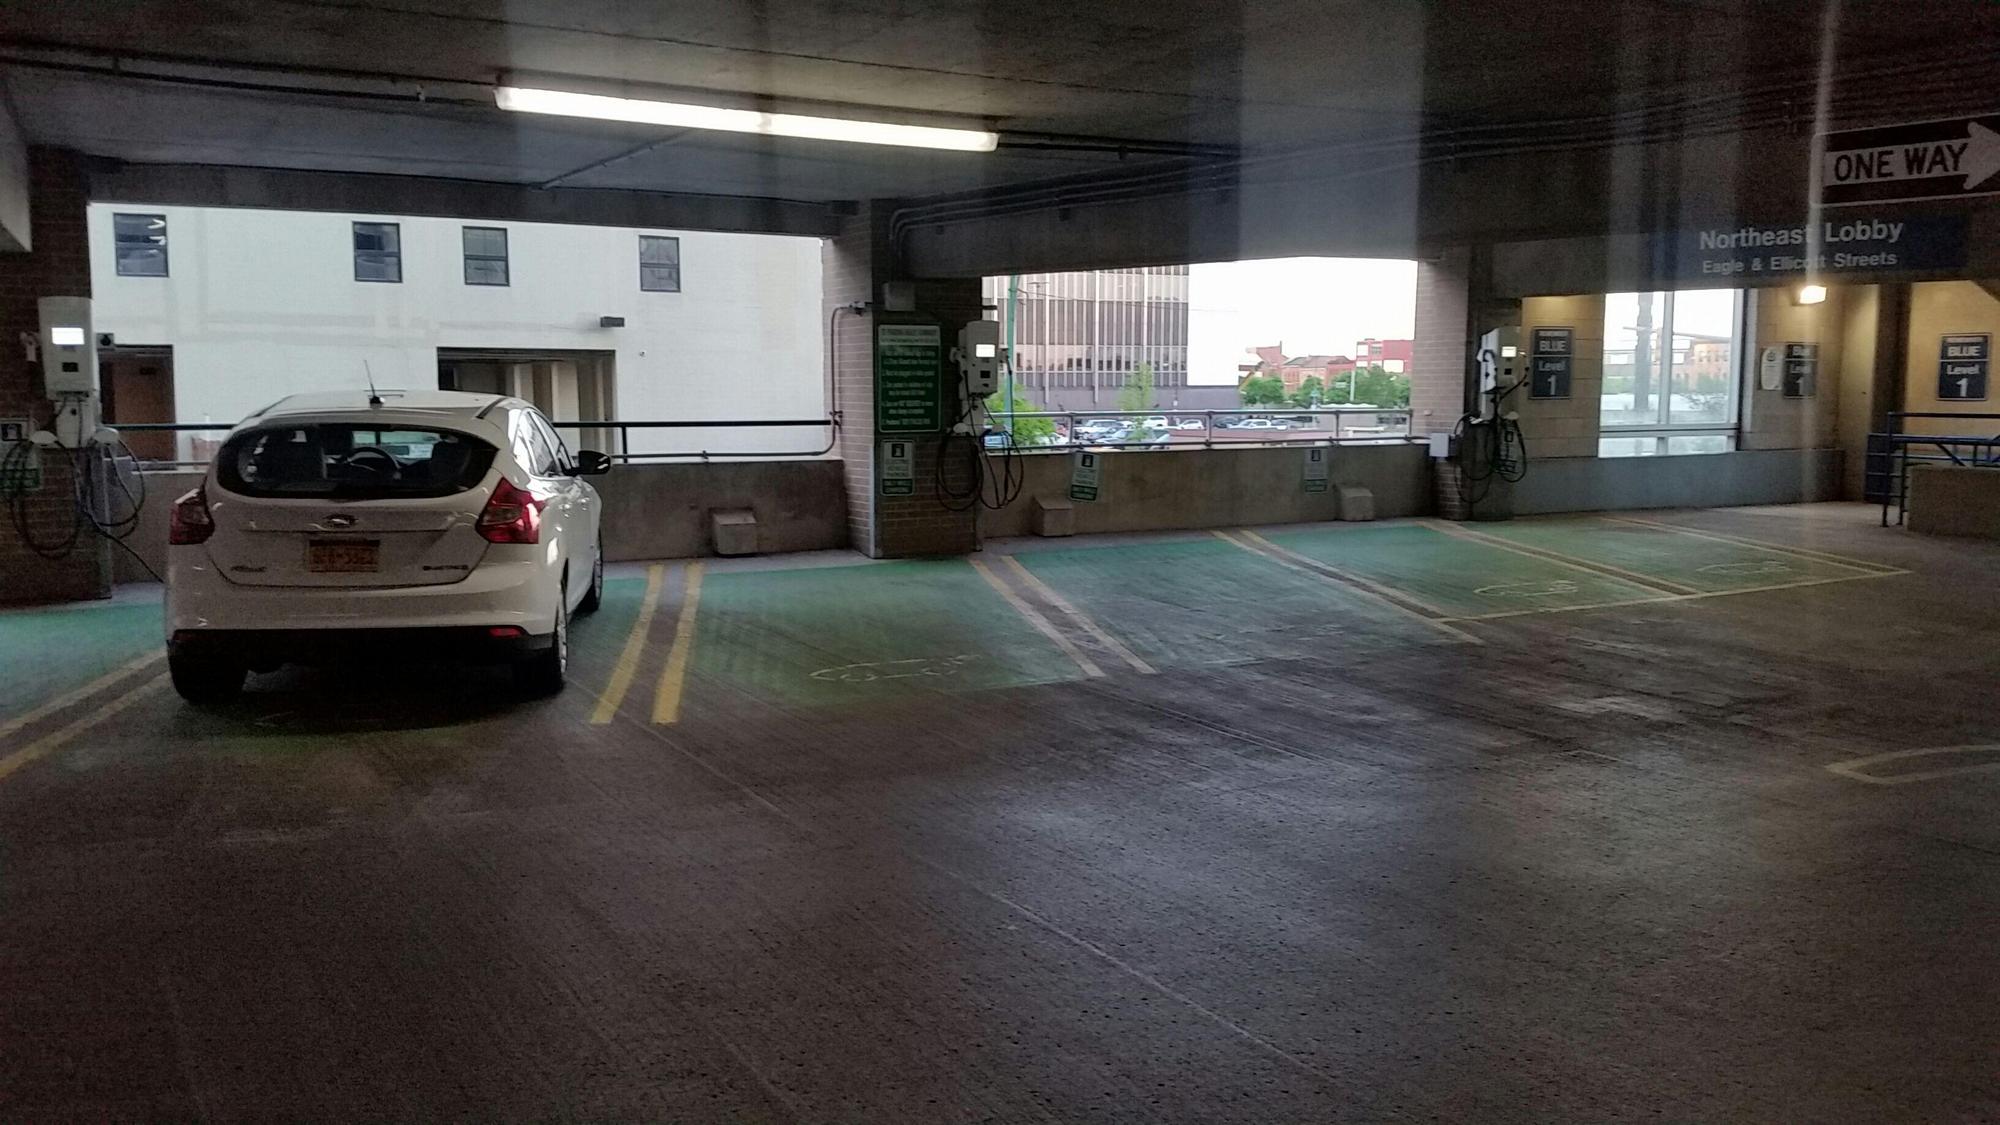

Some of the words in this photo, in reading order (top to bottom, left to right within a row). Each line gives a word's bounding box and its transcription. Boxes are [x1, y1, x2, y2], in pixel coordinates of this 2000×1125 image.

[1834, 150, 1893, 181] ONE
[1904, 142, 1968, 175] WAY
[1825, 219, 1904, 243] Lobby
[1702, 259, 1745, 276] Eagle
[1751, 258, 1763, 271] &
[1833, 252, 1898, 268] Streets
[1539, 340, 1567, 352] BLUE
[1948, 346, 1981, 357] BLUE
[1946, 364, 1980, 375] Level
[1547, 375, 1557, 395] 1
[1955, 378, 1968, 397] 1
